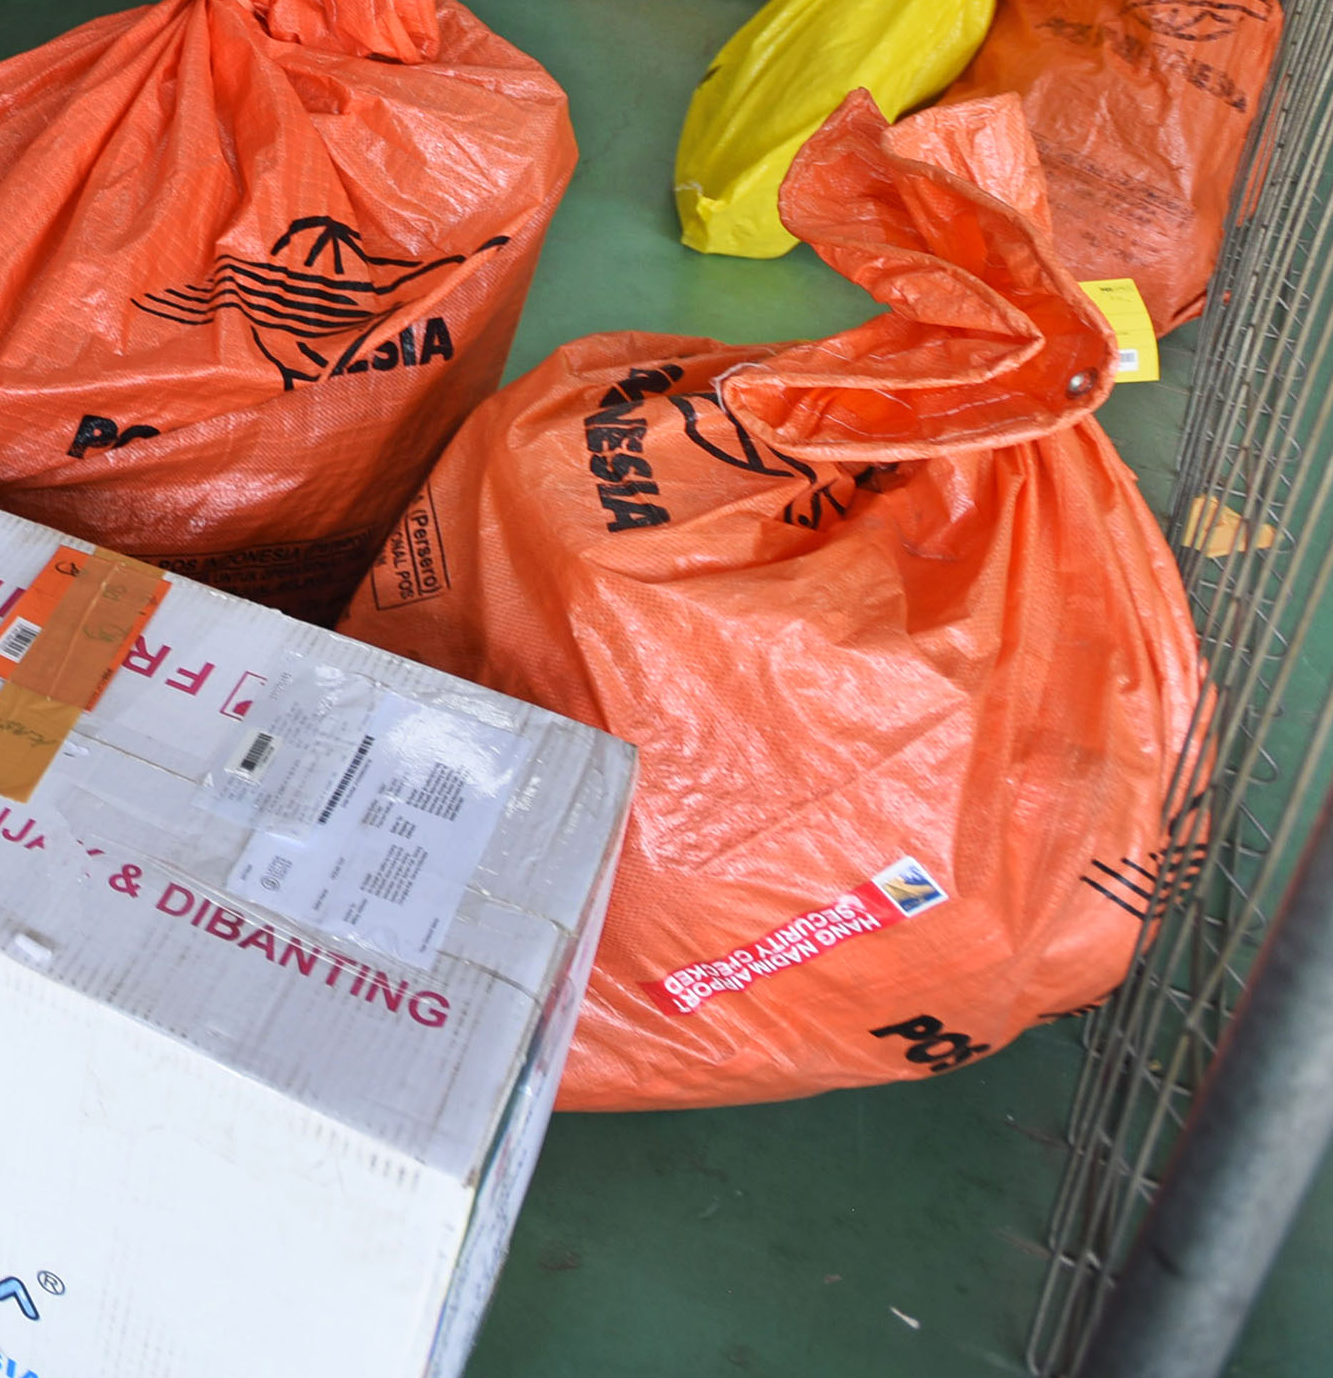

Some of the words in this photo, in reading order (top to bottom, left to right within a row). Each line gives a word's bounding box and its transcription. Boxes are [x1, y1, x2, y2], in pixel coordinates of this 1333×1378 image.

[411, 508, 444, 595] (Persero)
[108, 863, 144, 899] &
[156, 882, 452, 1029] DIBANTING
[755, 902, 857, 959] SECURITY
[814, 911, 882, 948] HANG
[748, 939, 820, 976] NADIM
[672, 971, 753, 1014] AIRPORT
